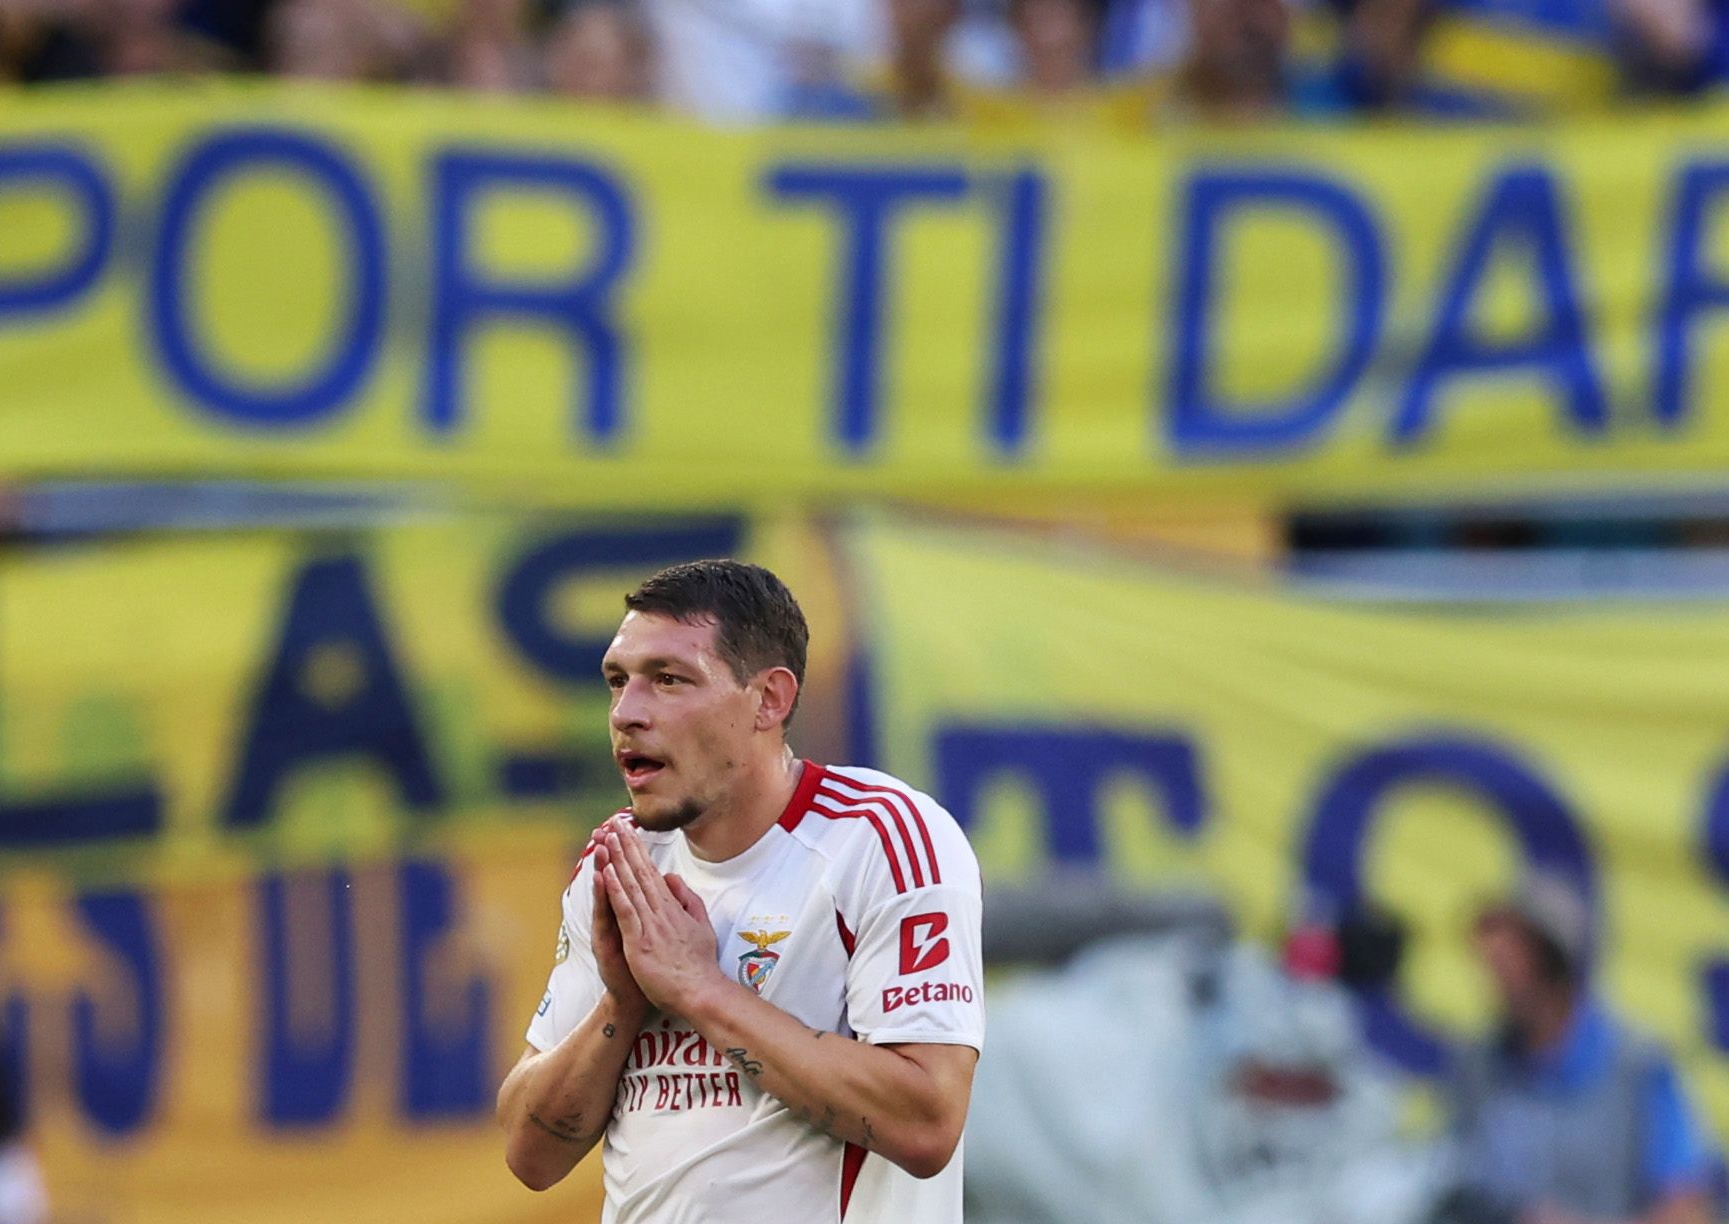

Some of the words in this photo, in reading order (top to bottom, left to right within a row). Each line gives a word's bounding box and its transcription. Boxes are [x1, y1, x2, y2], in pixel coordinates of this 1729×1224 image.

[758, 166, 1044, 456] TI
[882, 979, 974, 1014] Betano
[654, 1071, 743, 1111] BETTER
